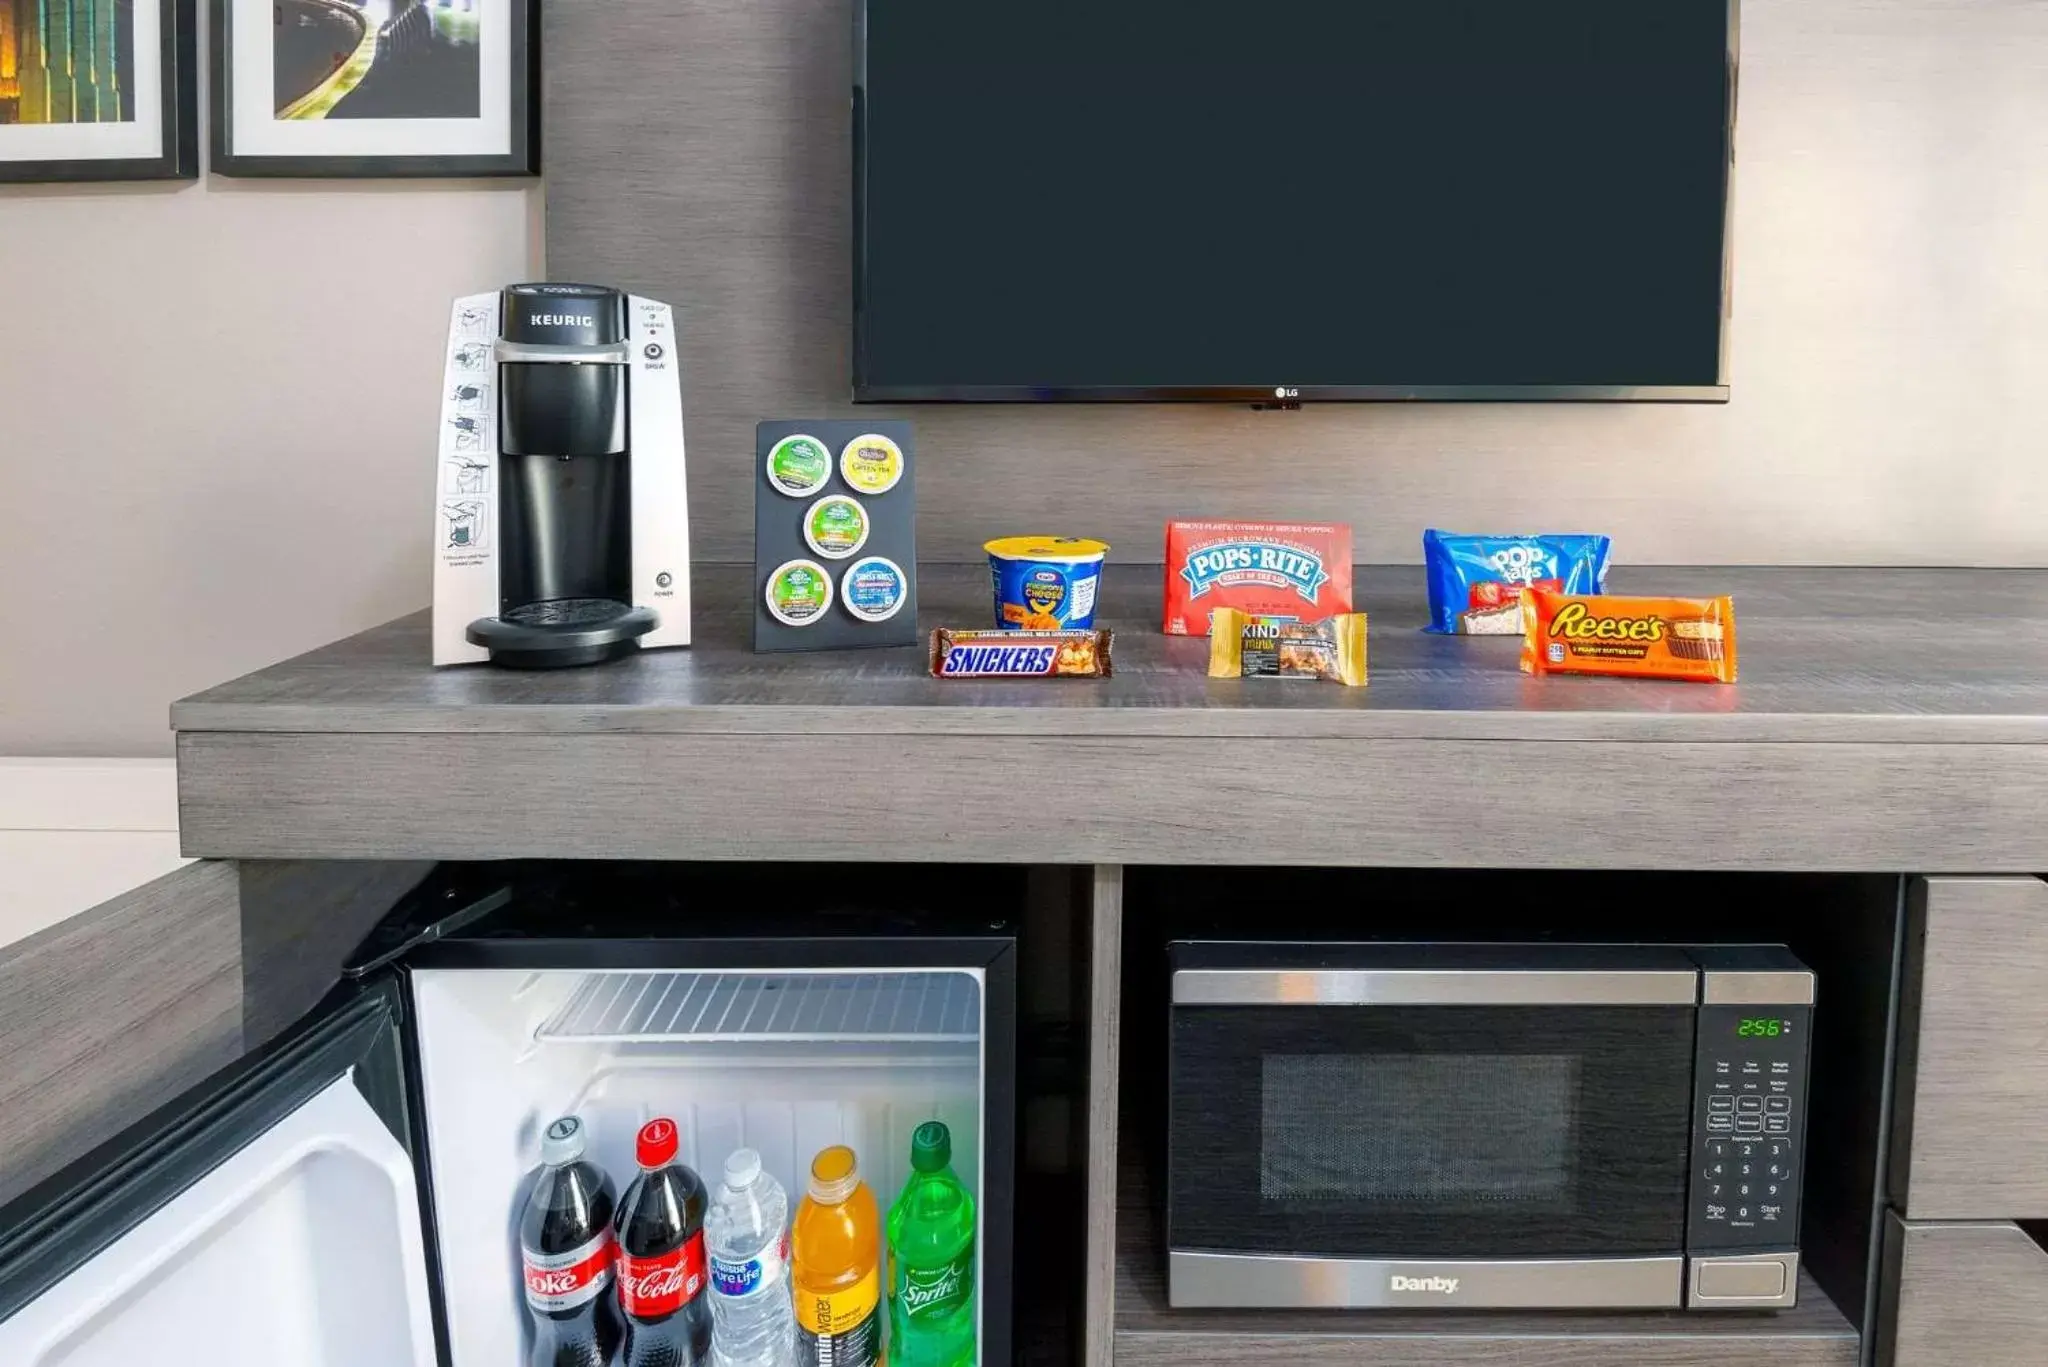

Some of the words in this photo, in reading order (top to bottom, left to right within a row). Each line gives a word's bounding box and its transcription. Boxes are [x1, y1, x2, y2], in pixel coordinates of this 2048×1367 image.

[531, 314, 593, 327] KEURIG
[1286, 389, 1298, 397] LG
[1242, 624, 1280, 638] KIND
[1603, 647, 1627, 655] BUTTER
[946, 646, 1054, 673] SNICKERS
[1739, 1019, 1780, 1036] 2:56
[1716, 1146, 1721, 1155] 1
[1744, 1145, 1751, 1155] 2
[1772, 1146, 1779, 1155] 3
[1714, 1165, 1722, 1173] 4
[1742, 1165, 1750, 1174] 5
[1770, 1165, 1778, 1174] 6
[1714, 1185, 1720, 1194] 7
[1741, 1185, 1749, 1195] 8
[1769, 1185, 1777, 1195] 9
[1707, 1204, 1726, 1213] Stop
[1740, 1207, 1748, 1217] 0
[1760, 1205, 1780, 1213] Start
[1391, 1275, 1460, 1294] Danby
[905, 1279, 958, 1305] Sprite
